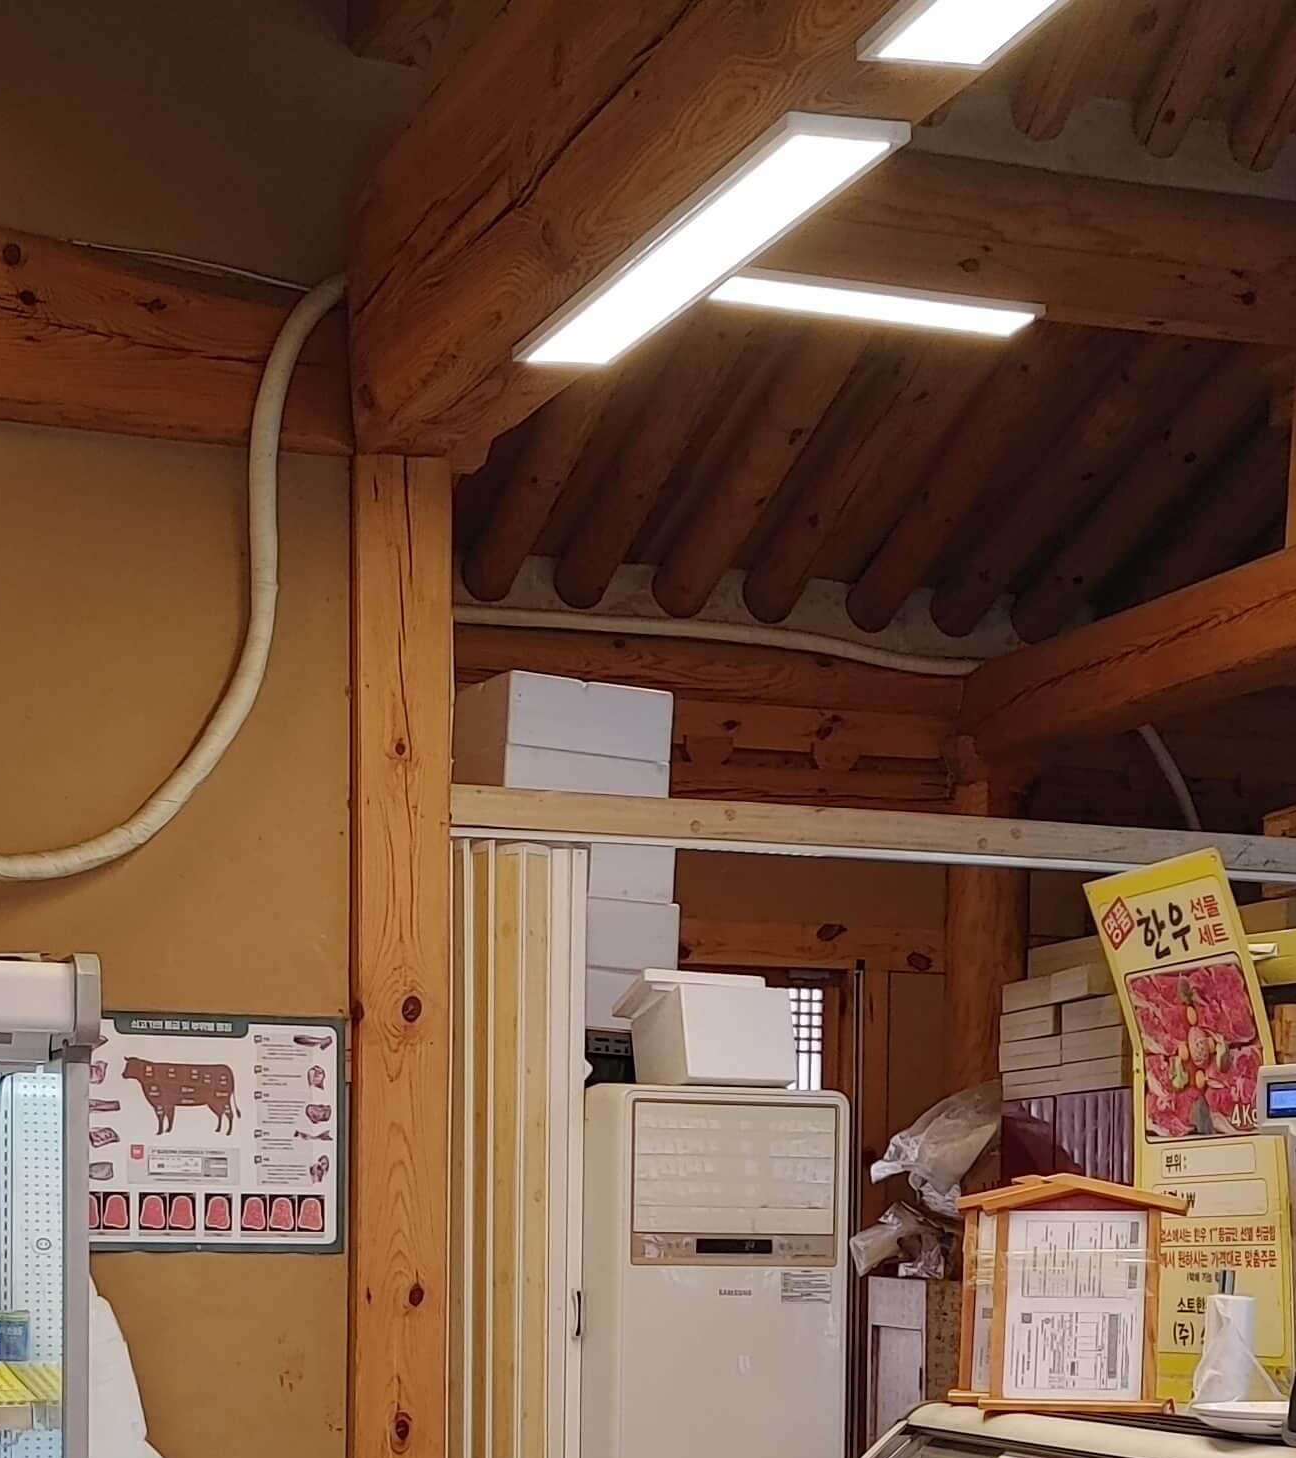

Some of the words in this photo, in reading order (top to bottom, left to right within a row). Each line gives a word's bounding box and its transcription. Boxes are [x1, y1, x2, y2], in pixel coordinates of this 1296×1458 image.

[1189, 894, 1220, 921] 선물
[1135, 901, 1192, 960] 한우
[1197, 922, 1230, 947] 세트
[1177, 1250, 1208, 1269] 원하시는
[1210, 1249, 1243, 1268] 가격대로
[1244, 1249, 1278, 1268] 맞춤주문
[718, 1288, 752, 1297] SAMSUNG
[1172, 1320, 1195, 1347] (주)
